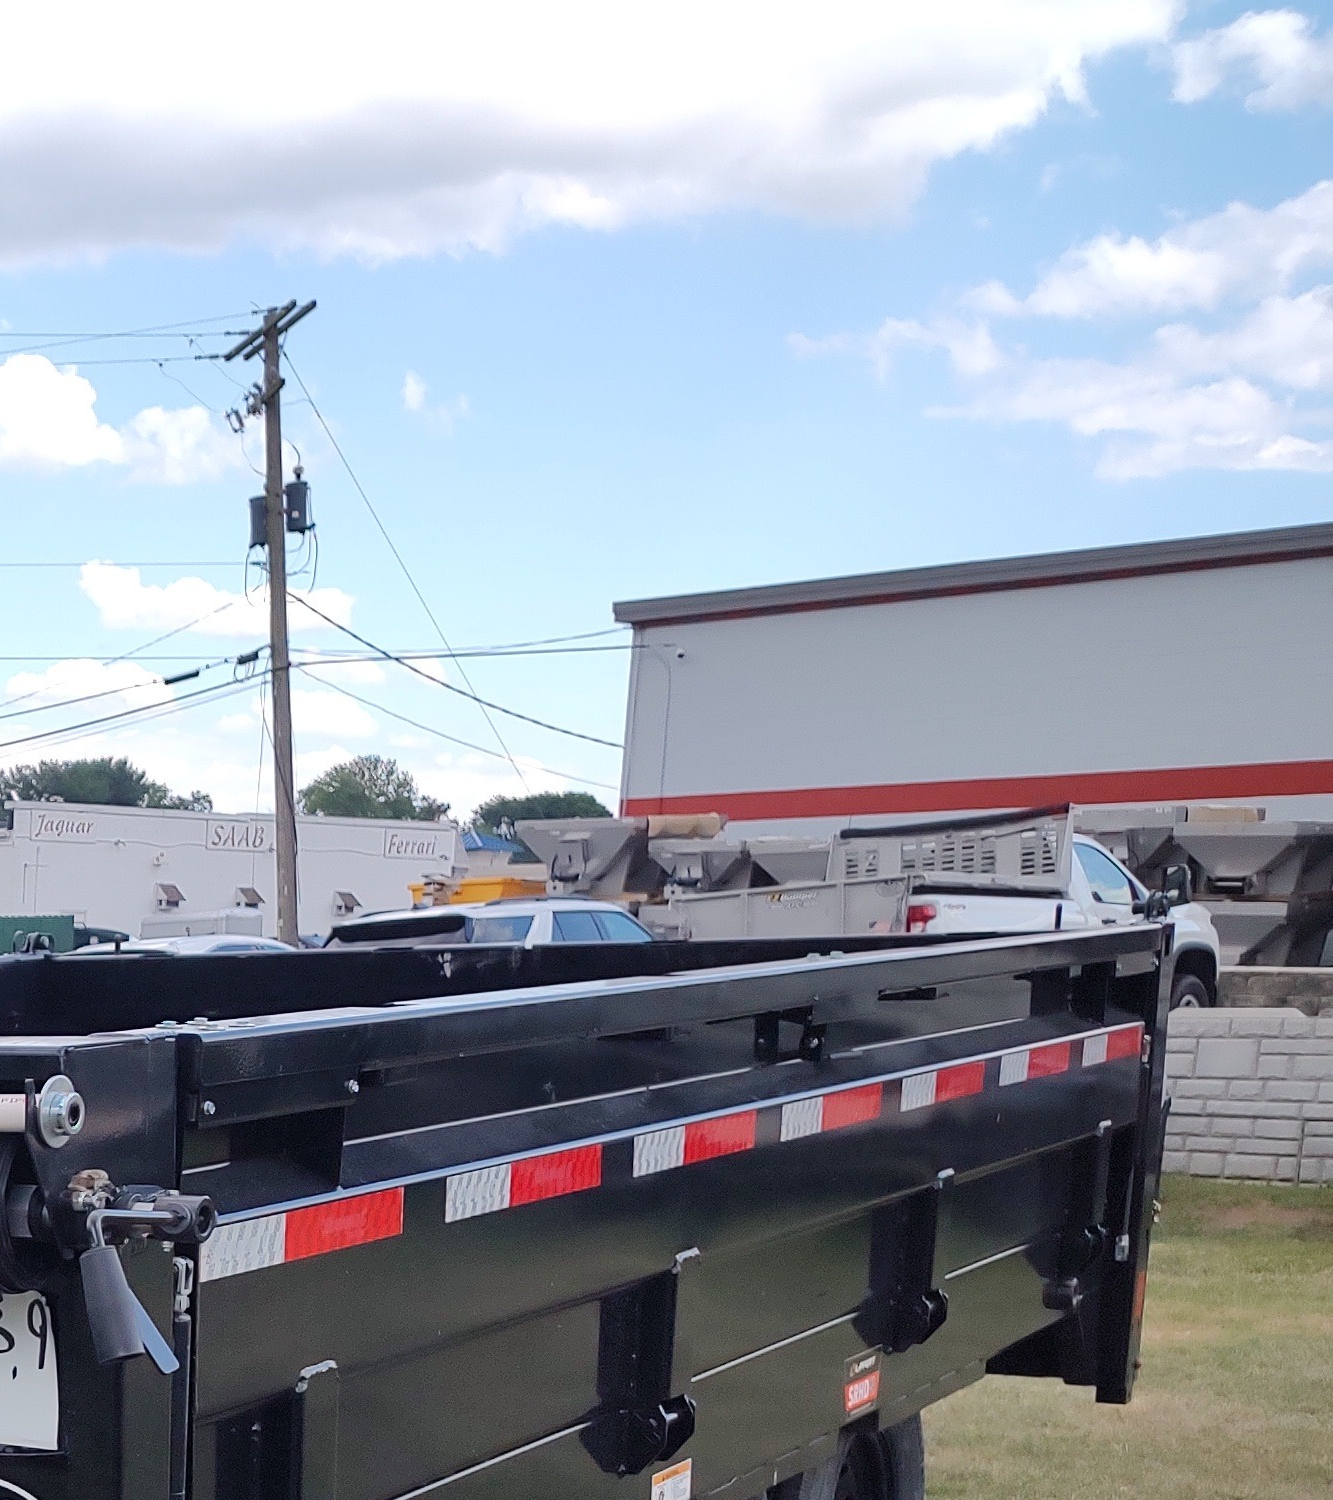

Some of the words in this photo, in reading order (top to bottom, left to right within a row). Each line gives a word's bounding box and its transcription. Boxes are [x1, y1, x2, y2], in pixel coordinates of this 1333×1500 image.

[35, 814, 94, 838] Jaguar
[211, 824, 266, 849] SAAB
[388, 834, 438, 855] Ferrari
